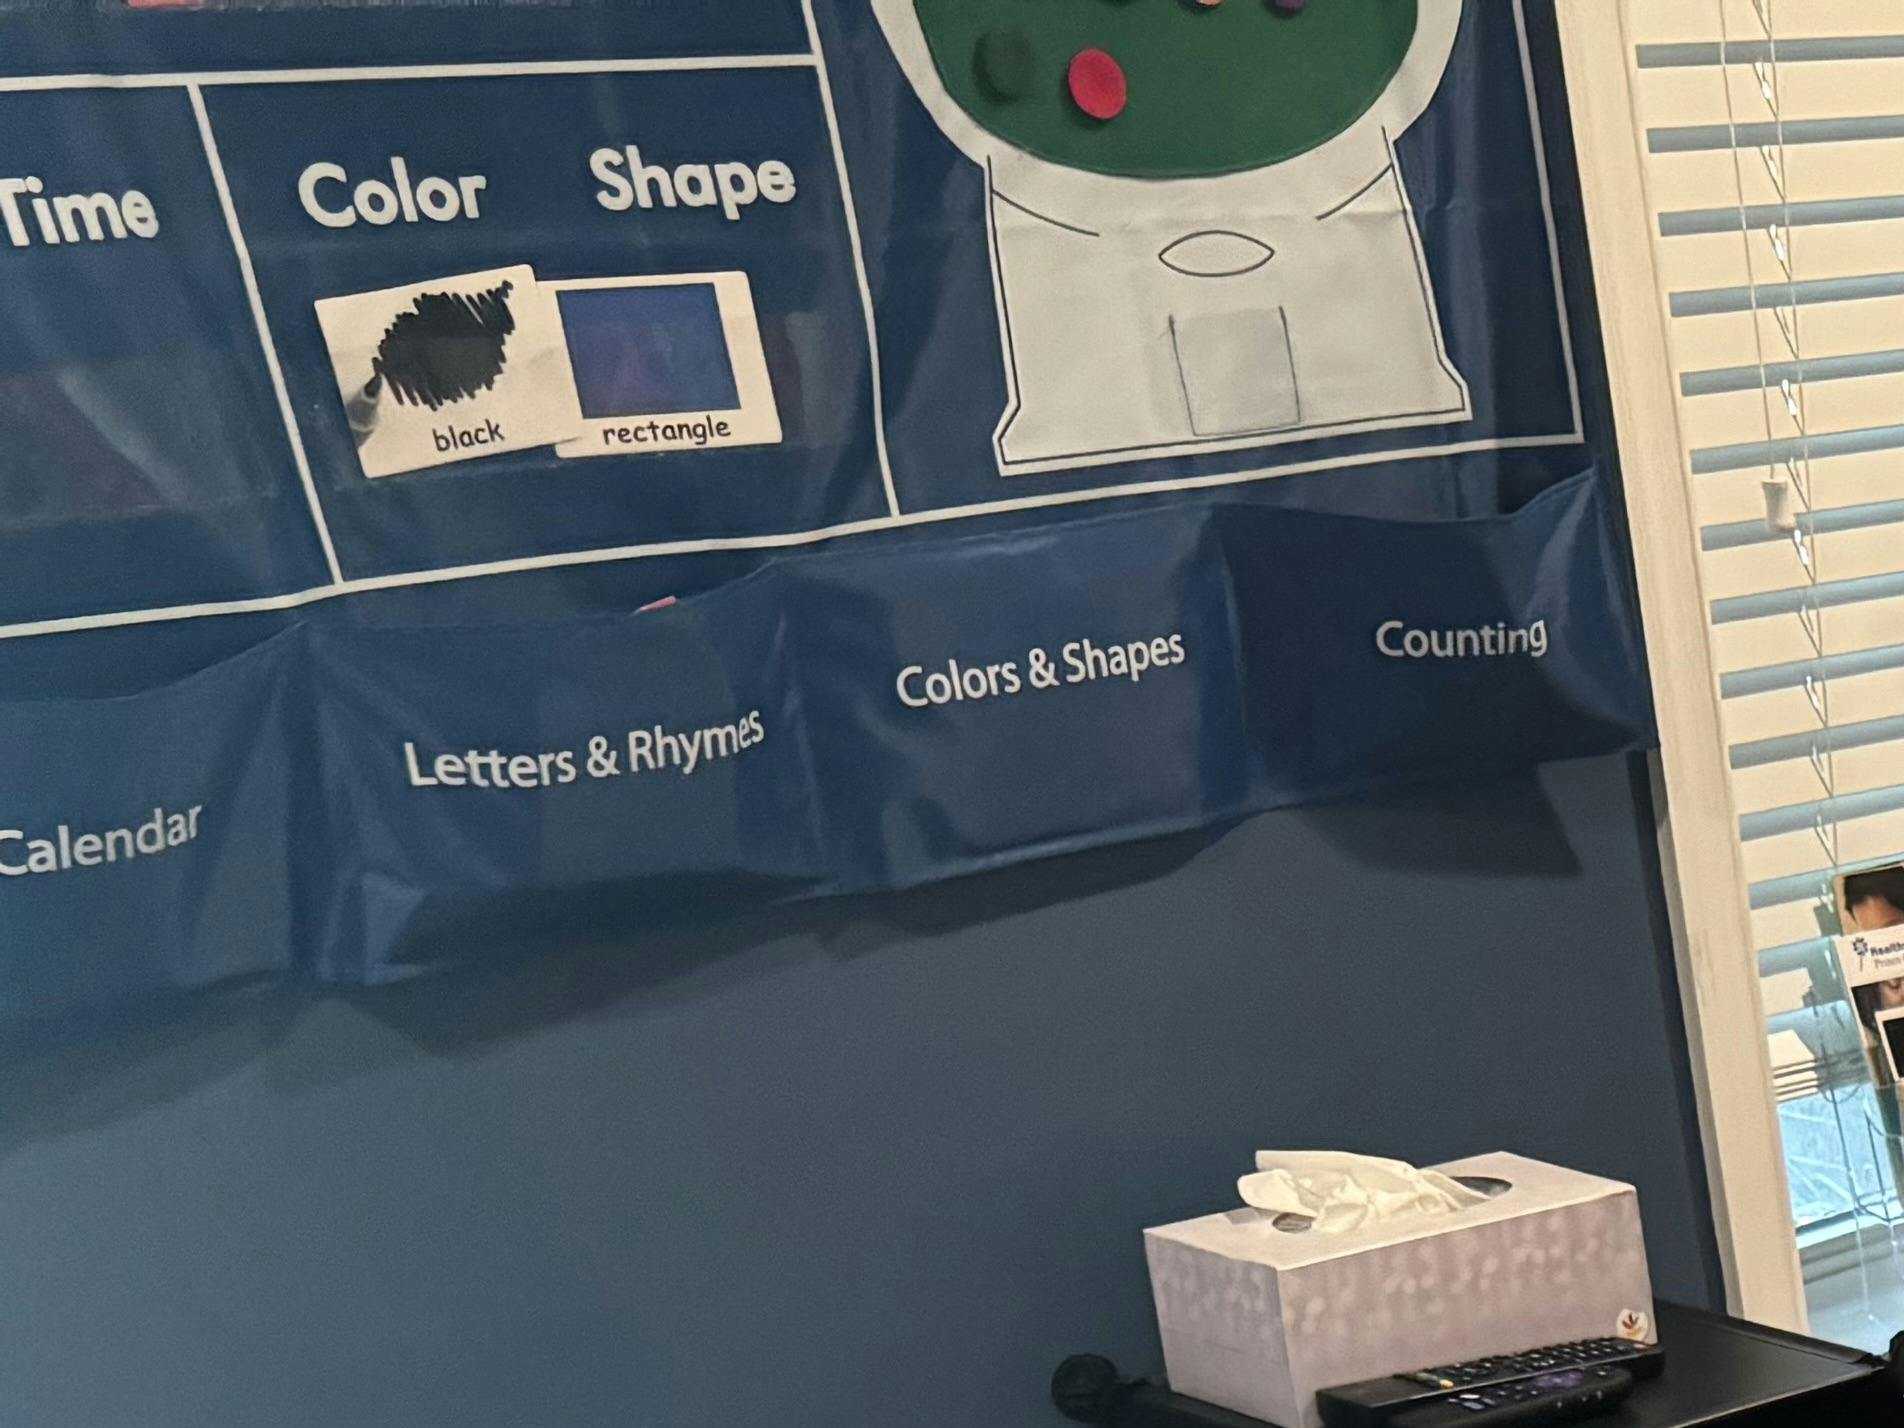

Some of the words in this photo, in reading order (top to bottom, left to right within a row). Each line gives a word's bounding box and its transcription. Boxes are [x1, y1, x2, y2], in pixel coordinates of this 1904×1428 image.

[0, 176, 160, 247] Time
[298, 156, 487, 228] Color
[589, 145, 798, 220] Shape
[432, 419, 505, 453] black
[602, 416, 732, 450] rectangle
[896, 650, 1022, 708] Colors
[1028, 648, 1061, 689] &
[1065, 632, 1186, 685] Shapes
[1375, 619, 1548, 660] Counting
[404, 740, 577, 789] Letters
[586, 735, 620, 777] &
[628, 707, 766, 776] Rhymes
[0, 802, 204, 876] Calendar
